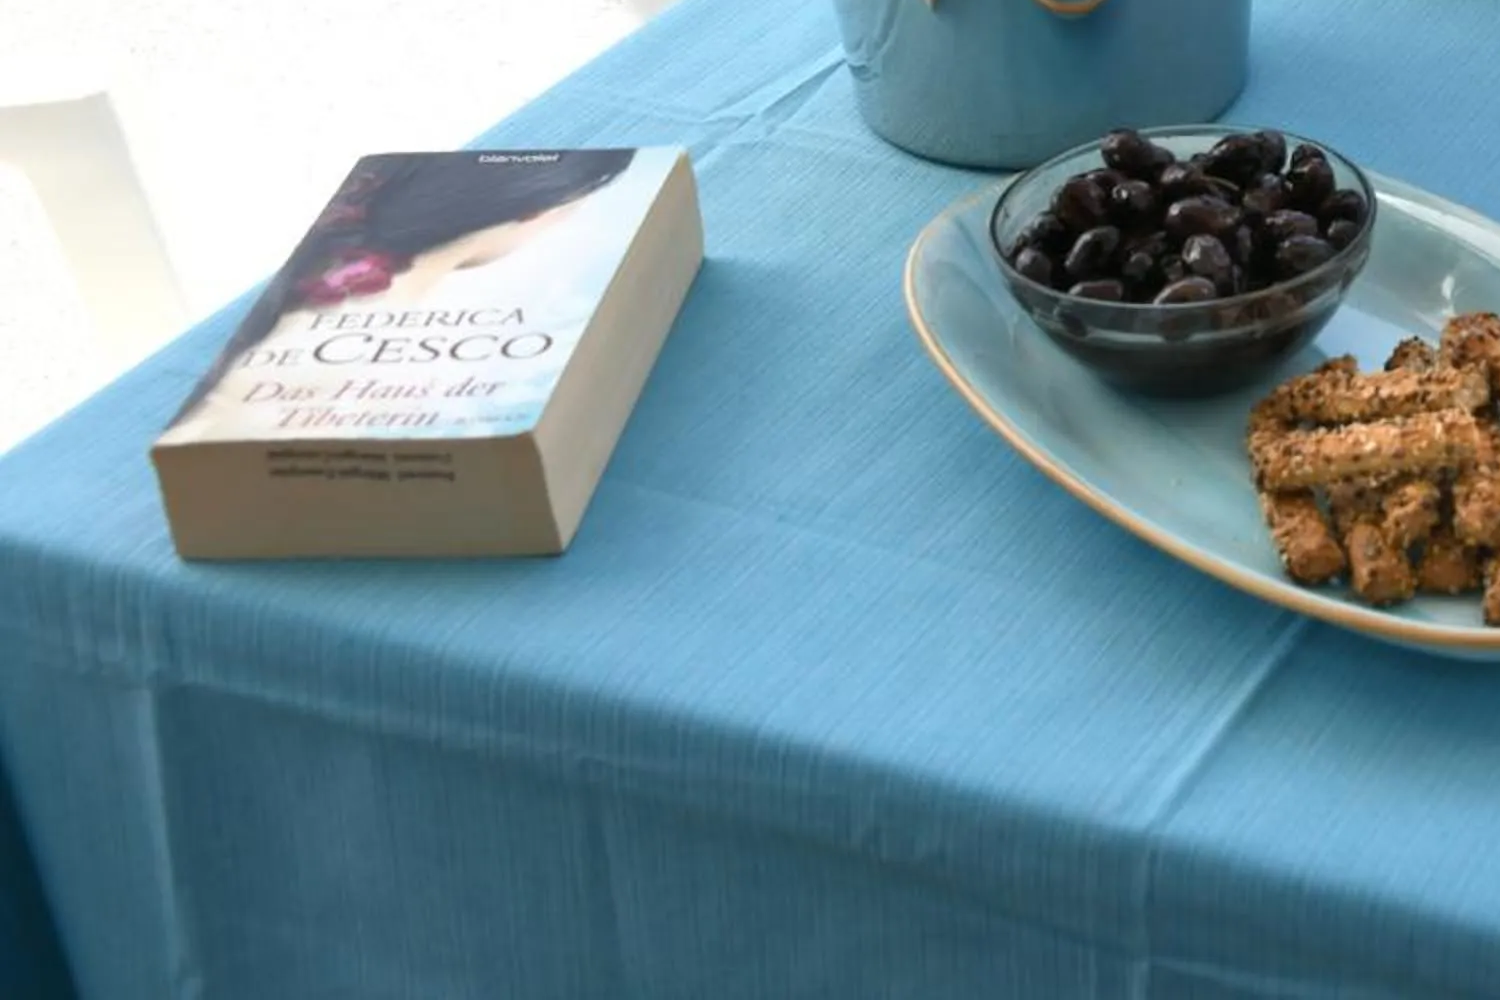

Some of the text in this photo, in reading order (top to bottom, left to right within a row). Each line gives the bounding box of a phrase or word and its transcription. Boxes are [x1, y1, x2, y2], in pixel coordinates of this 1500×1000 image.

[309, 307, 526, 331] FEDERICA
[241, 332, 554, 368] DE CESCO
[242, 374, 509, 404] Das Haus der
